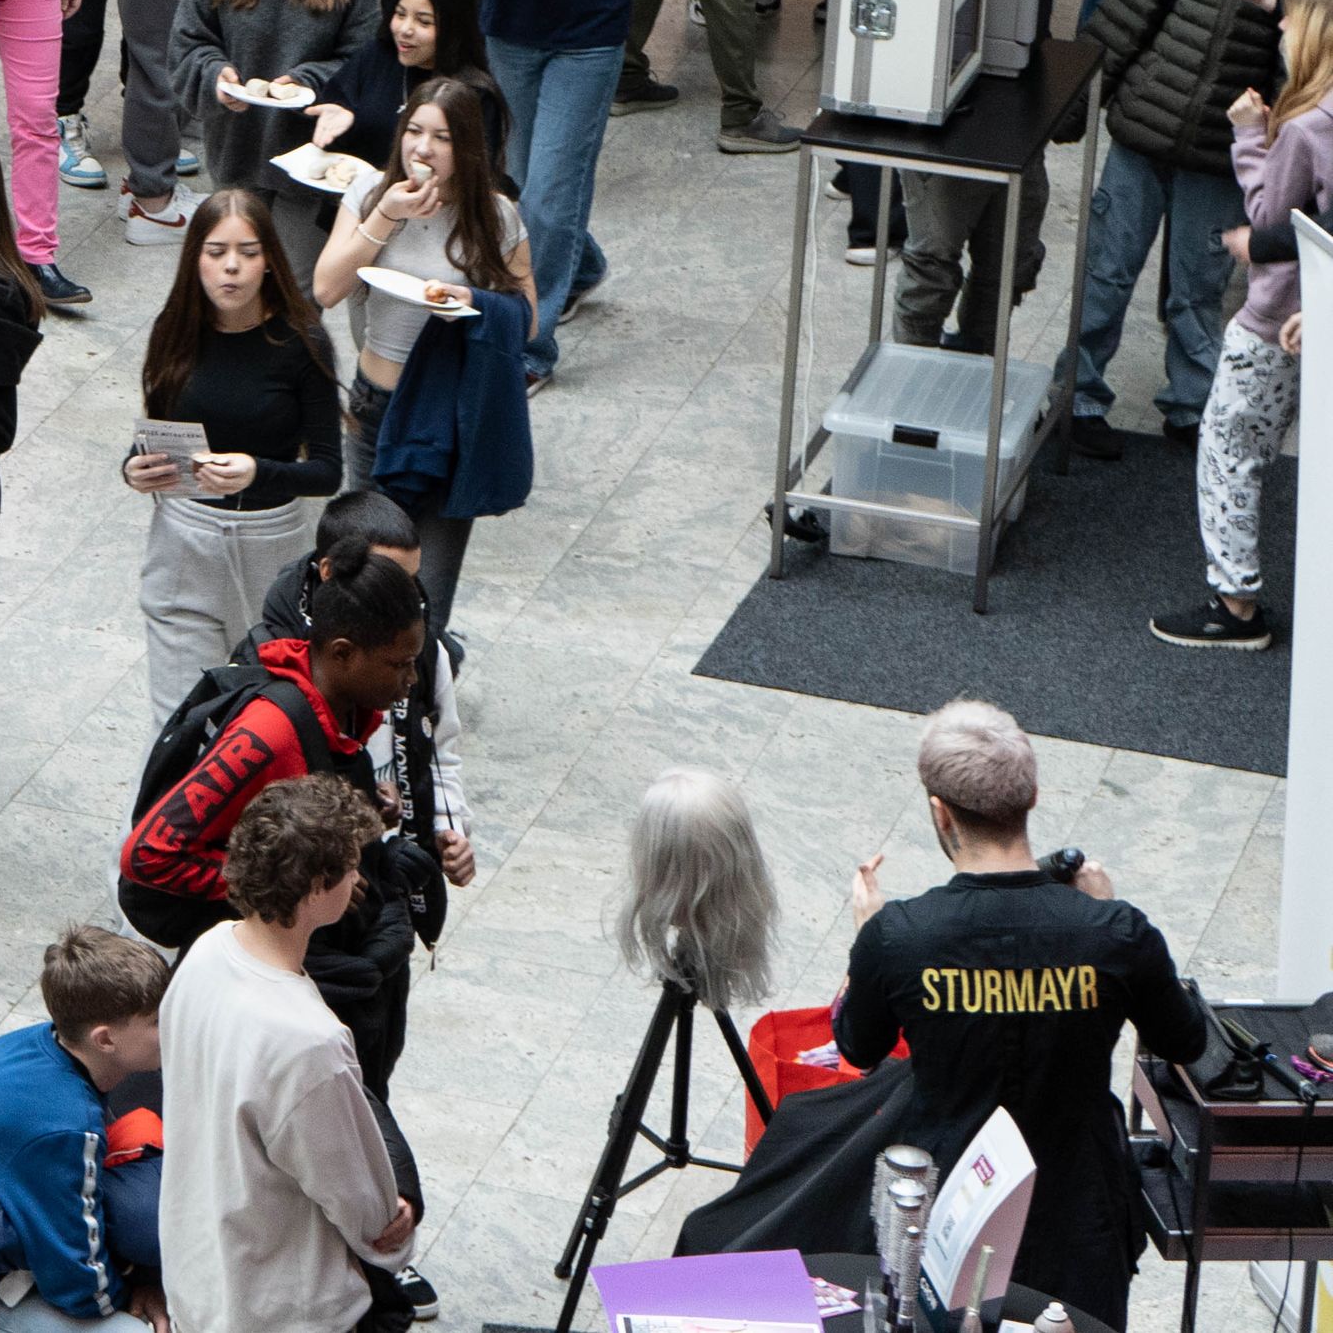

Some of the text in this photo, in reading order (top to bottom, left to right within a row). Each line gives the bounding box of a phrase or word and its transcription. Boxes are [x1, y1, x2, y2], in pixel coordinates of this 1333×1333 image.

[184, 732, 269, 822] AIR
[394, 734, 416, 821] MONCLER
[921, 965, 1099, 1013] STURMAYR
